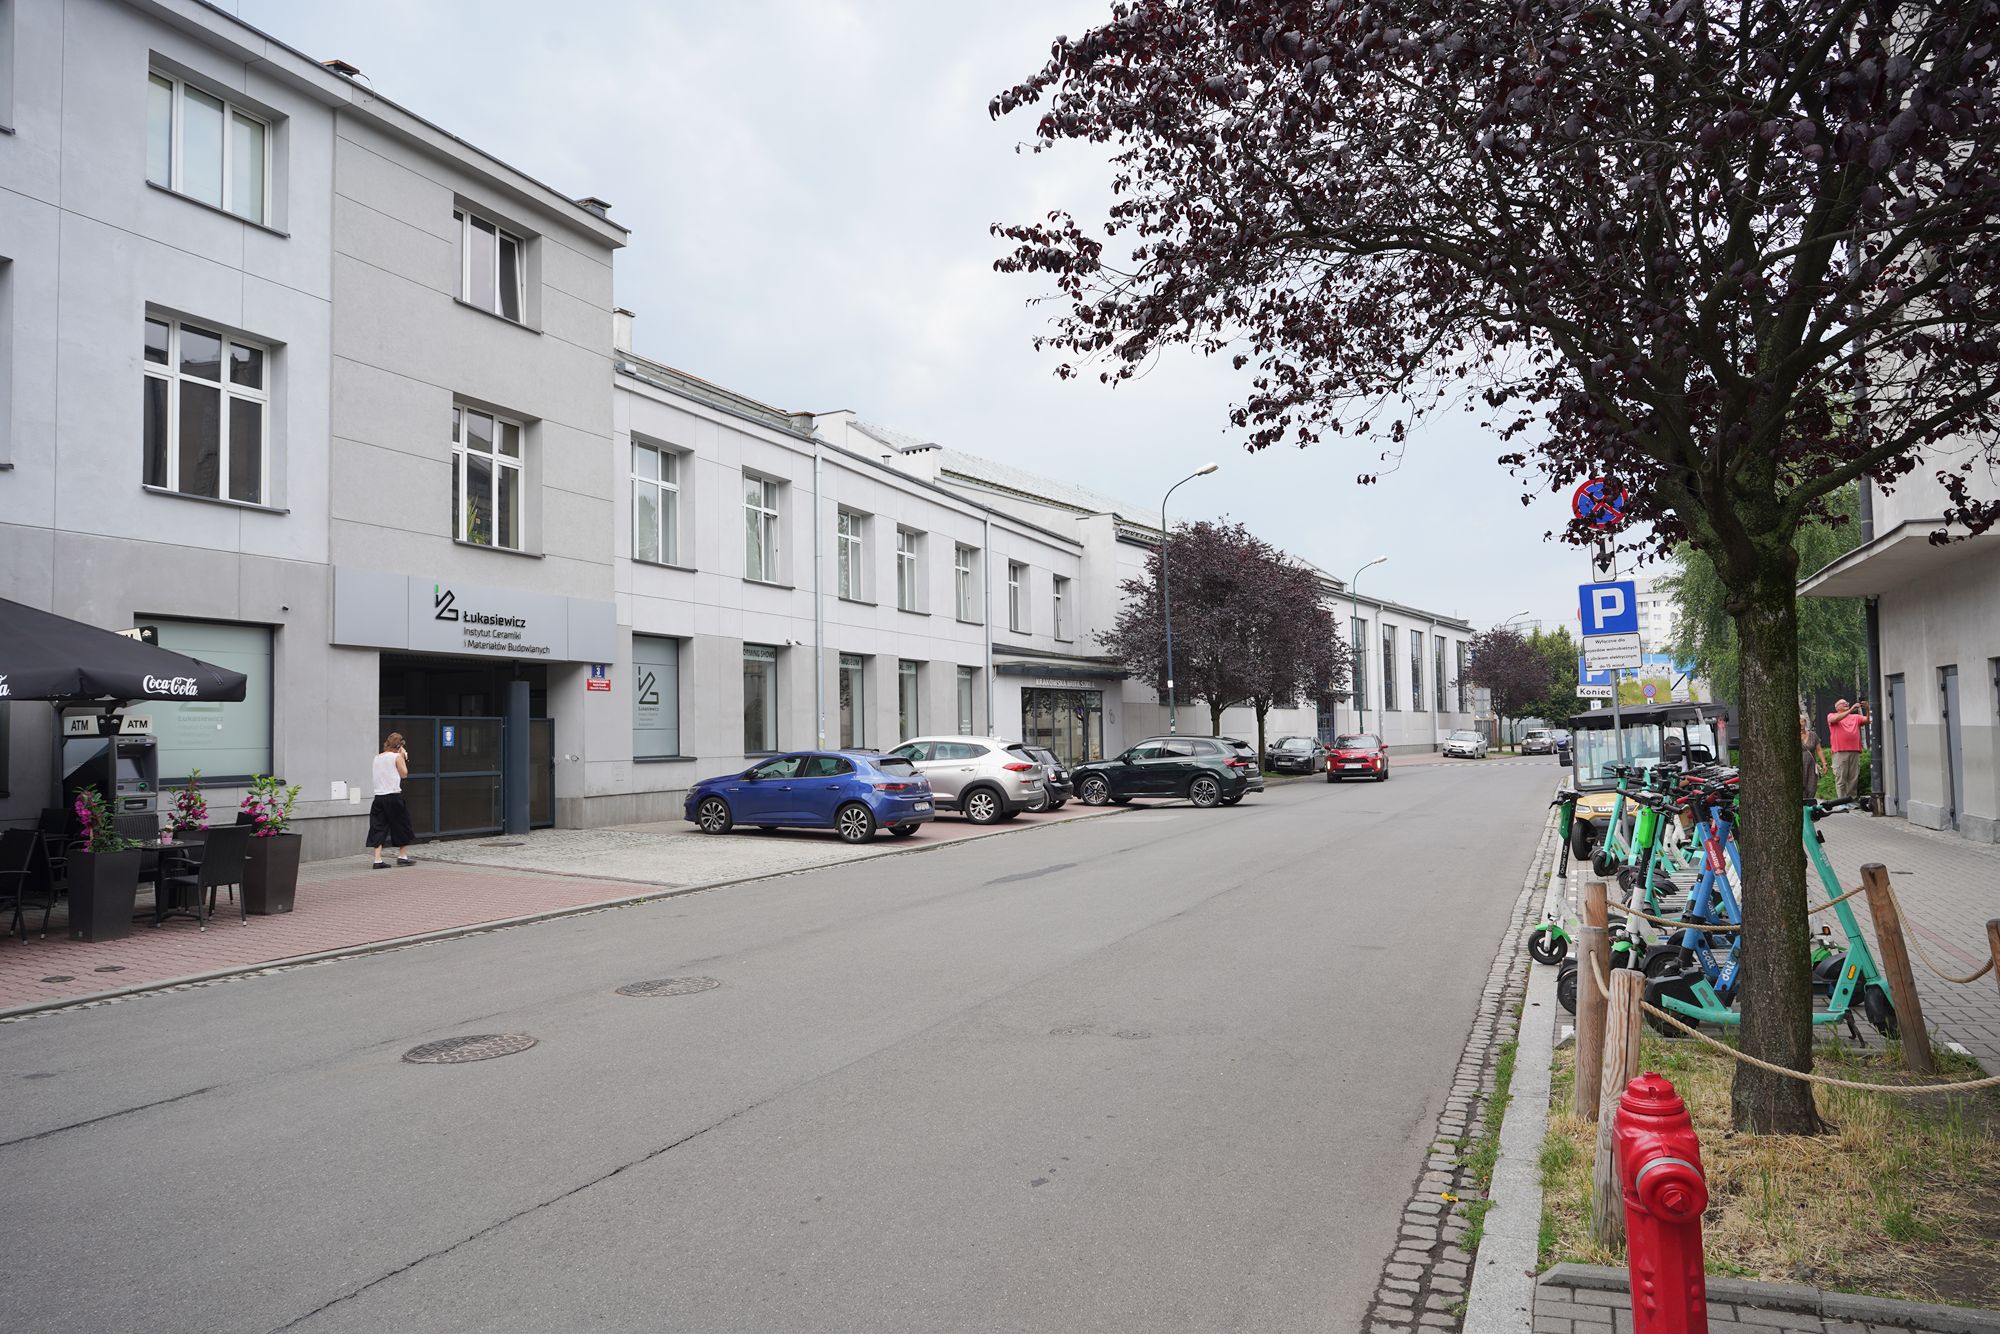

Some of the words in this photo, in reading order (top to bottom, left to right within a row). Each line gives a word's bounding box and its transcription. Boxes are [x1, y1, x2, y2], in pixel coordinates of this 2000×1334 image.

[1592, 587, 1625, 629] P
[463, 611, 526, 628] Łukasiewicz
[463, 627, 491, 638] Instytut
[492, 629, 522, 640] Ceramiki
[467, 640, 506, 651] Materiałów
[507, 643, 551, 655] Budowlanych
[143, 674, 199, 696] Coca-Cola
[1579, 687, 1611, 696] Koniec
[71, 719, 89, 732] ATM
[127, 720, 148, 729] ATM
[1722, 960, 1737, 982] dott
